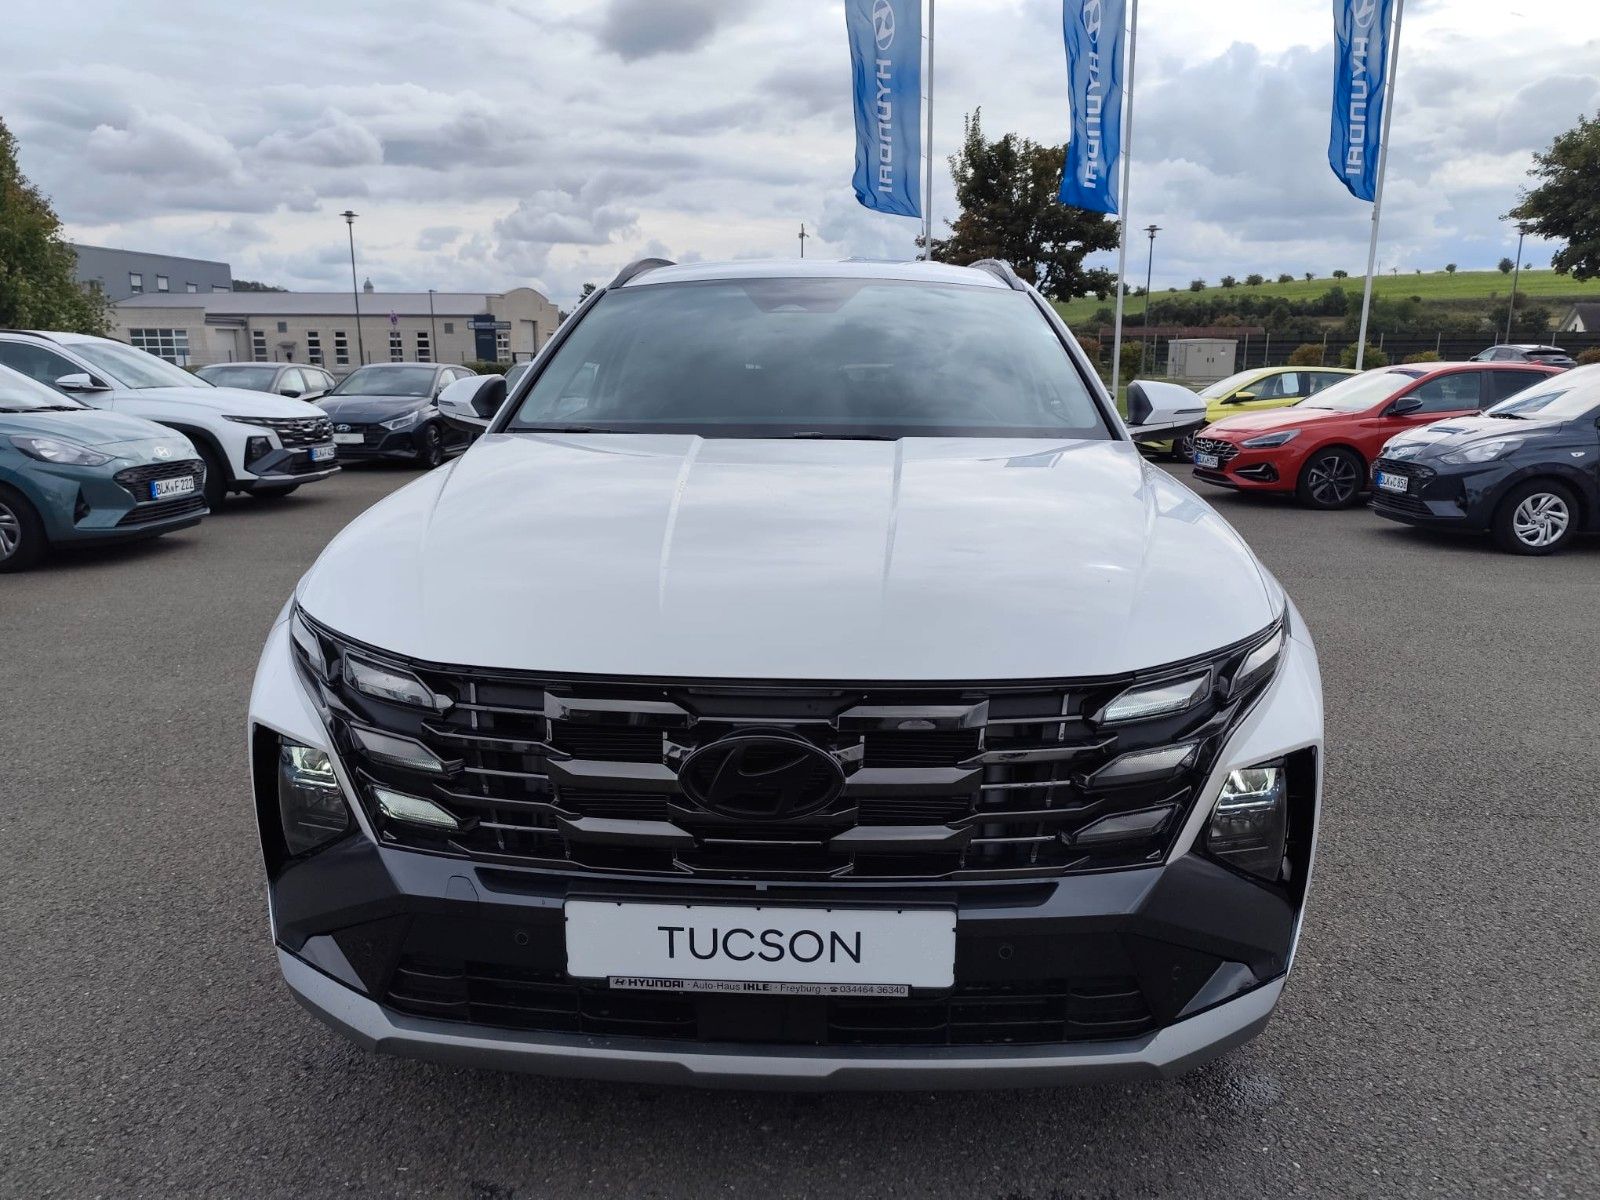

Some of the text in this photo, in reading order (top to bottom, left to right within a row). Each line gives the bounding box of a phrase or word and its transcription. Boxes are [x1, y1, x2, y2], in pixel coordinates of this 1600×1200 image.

[156, 481, 170, 495] BLK
[181, 478, 194, 490] 222
[657, 926, 862, 964] TUCSON
[628, 978, 906, 994] HYUNDAI Auto-Haus IHLE Freyburg 034464 36340
